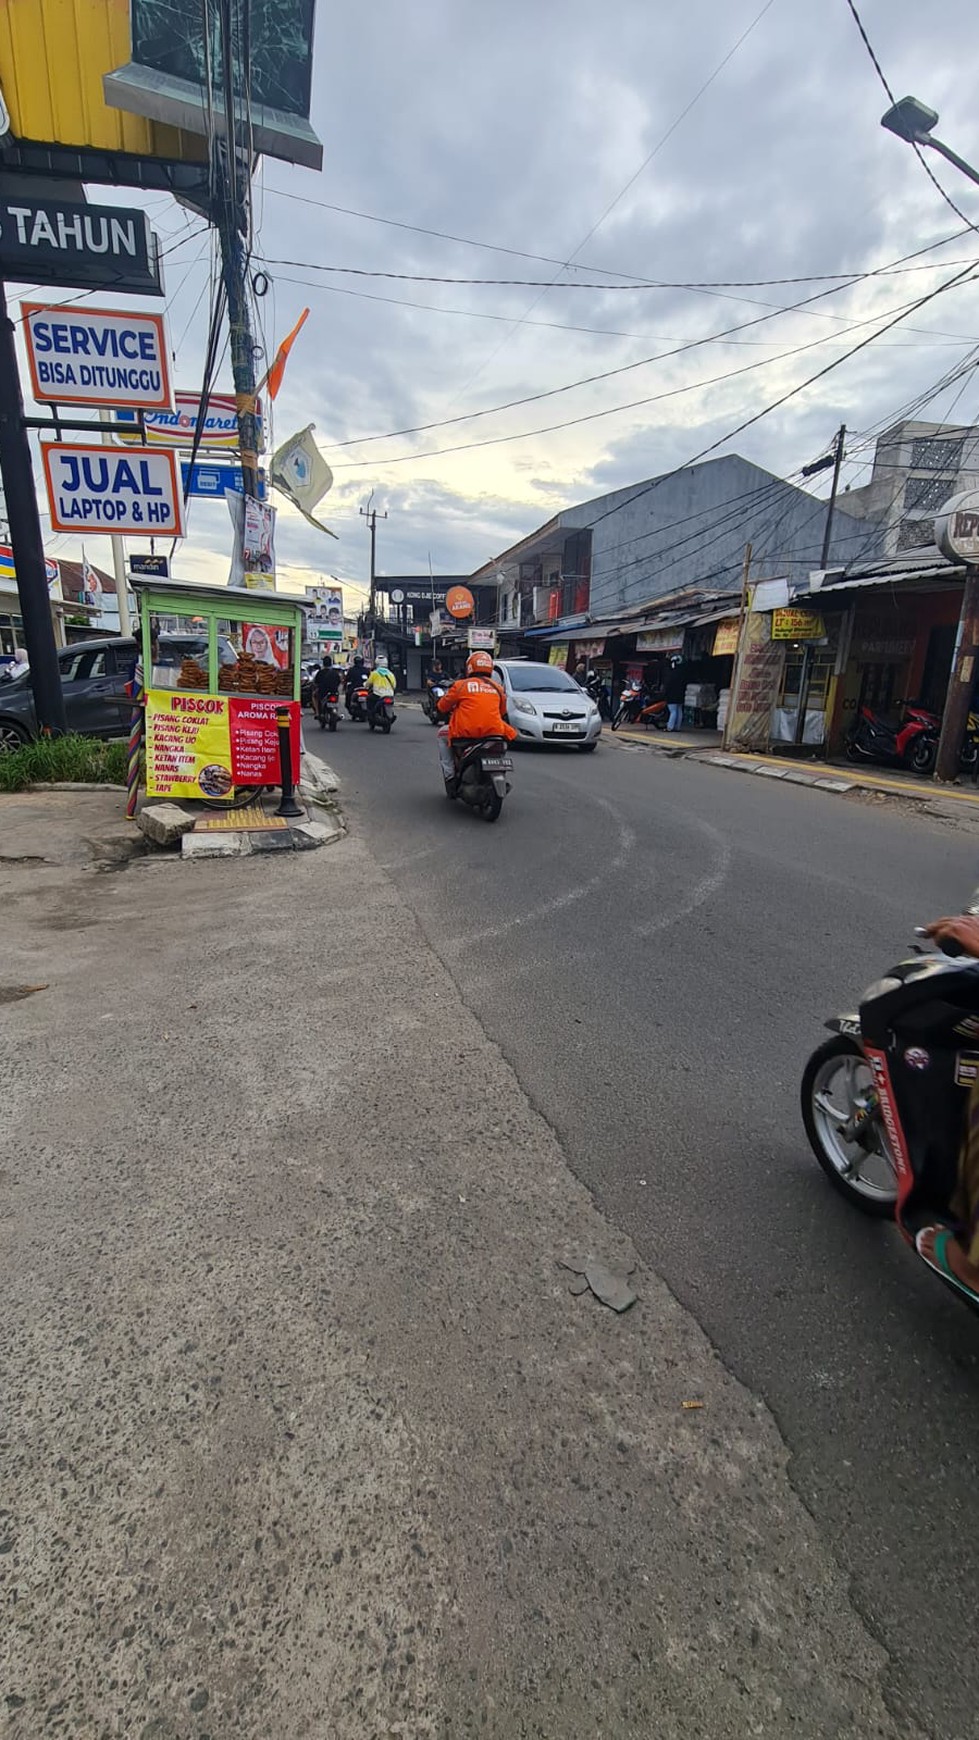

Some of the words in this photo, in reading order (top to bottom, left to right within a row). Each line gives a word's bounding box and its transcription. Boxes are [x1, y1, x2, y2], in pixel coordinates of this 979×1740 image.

[7, 206, 136, 256] TAHUN
[33, 322, 157, 360] SERVICE
[39, 361, 77, 386] BISA
[80, 366, 161, 391] DITUNGGU
[60, 456, 163, 496] JUAL
[60, 497, 126, 522] LAPTOP
[132, 502, 144, 521] &
[148, 501, 171, 524] HP
[171, 696, 224, 715] PISCOK
[153, 713, 181, 723] PISANG
[181, 716, 209, 726] COKLAT
[238, 711, 269, 720] AROMA
[153, 724, 181, 733] PISANG
[240, 729, 263, 738] Pisang
[153, 734, 184, 744] KACANG
[240, 738, 264, 746] Pisang
[153, 744, 185, 753] NANGKA
[154, 754, 178, 763] KETAN
[154, 764, 180, 773] NANAS
[240, 762, 267, 770] Nangka
[878, 1087, 907, 1176] BRIDGESTONE
